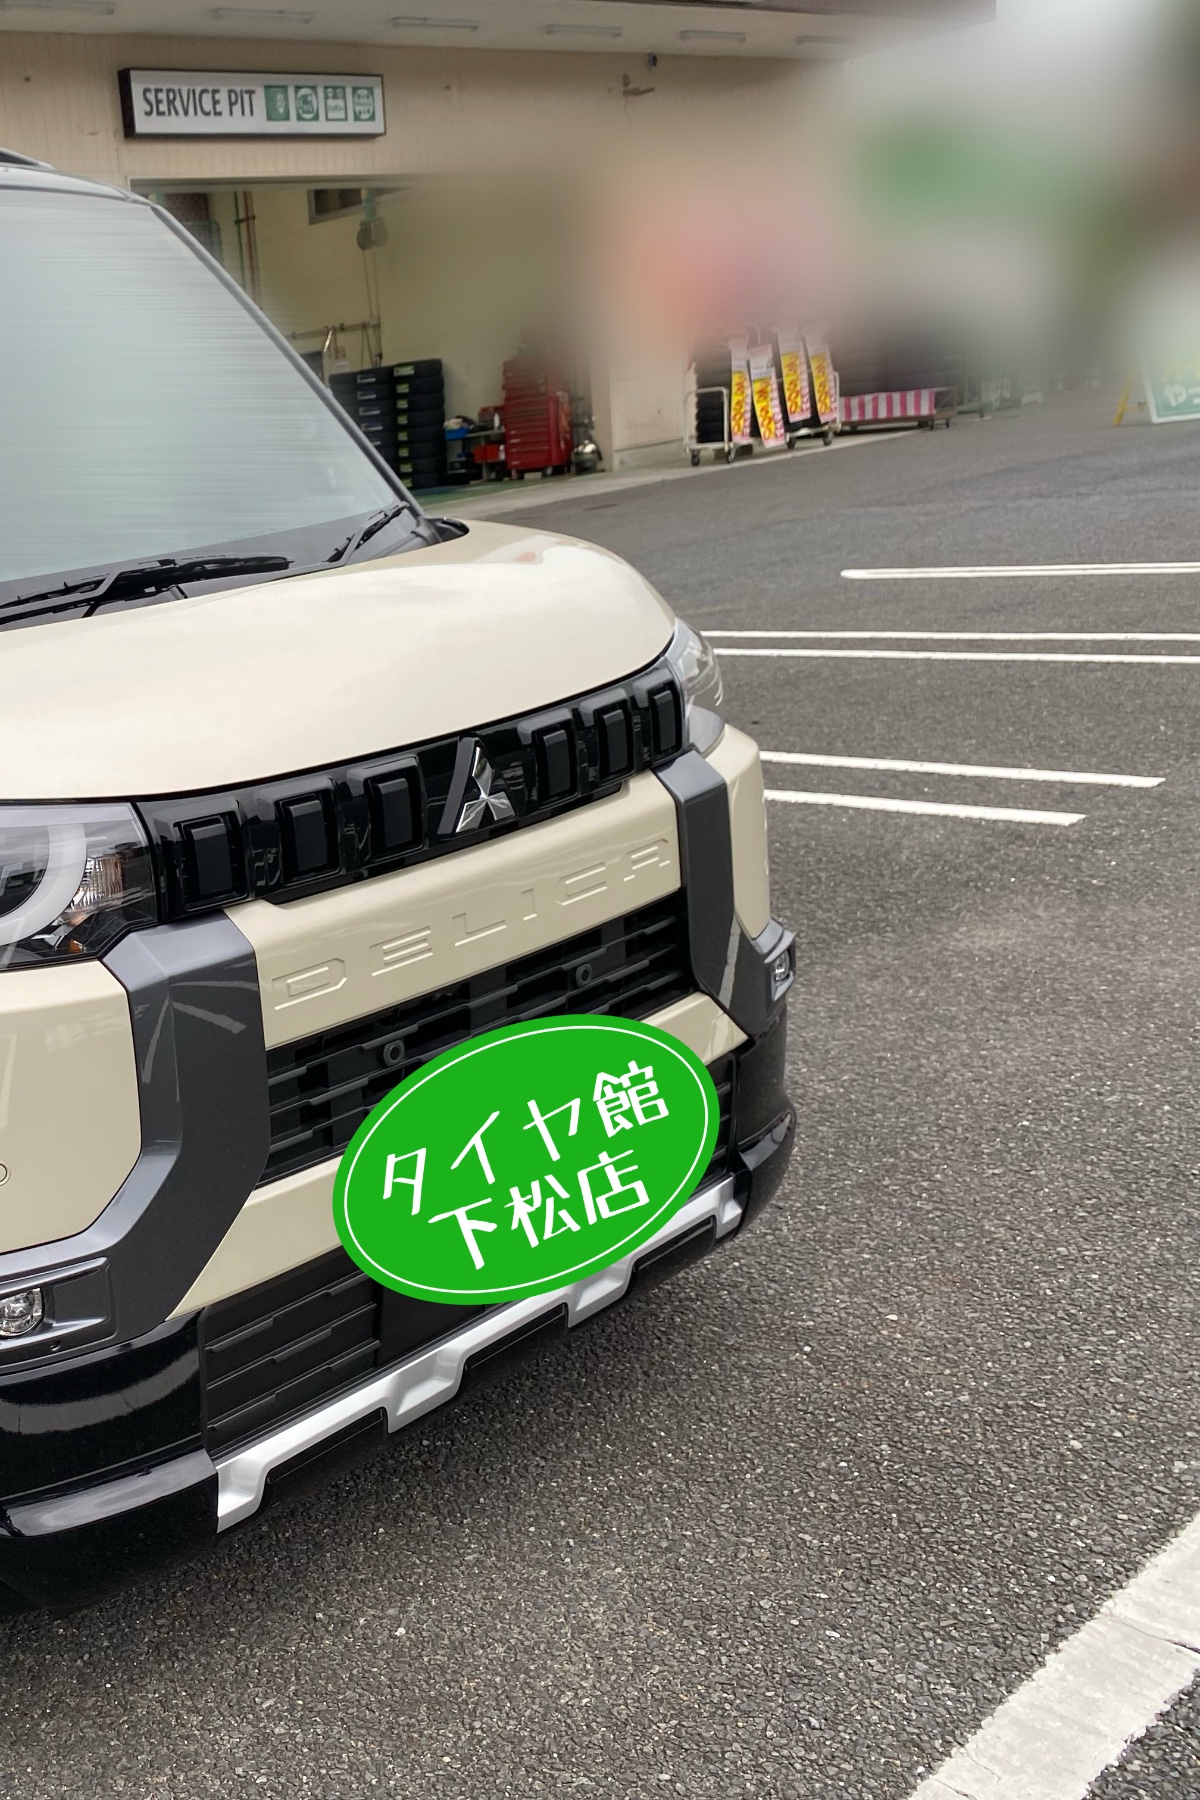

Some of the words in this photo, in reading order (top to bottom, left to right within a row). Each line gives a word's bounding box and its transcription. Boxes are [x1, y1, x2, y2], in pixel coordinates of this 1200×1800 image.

[142, 86, 223, 118] SERVICE
[227, 88, 256, 117] PIT
[271, 838, 671, 1010] DELICA
